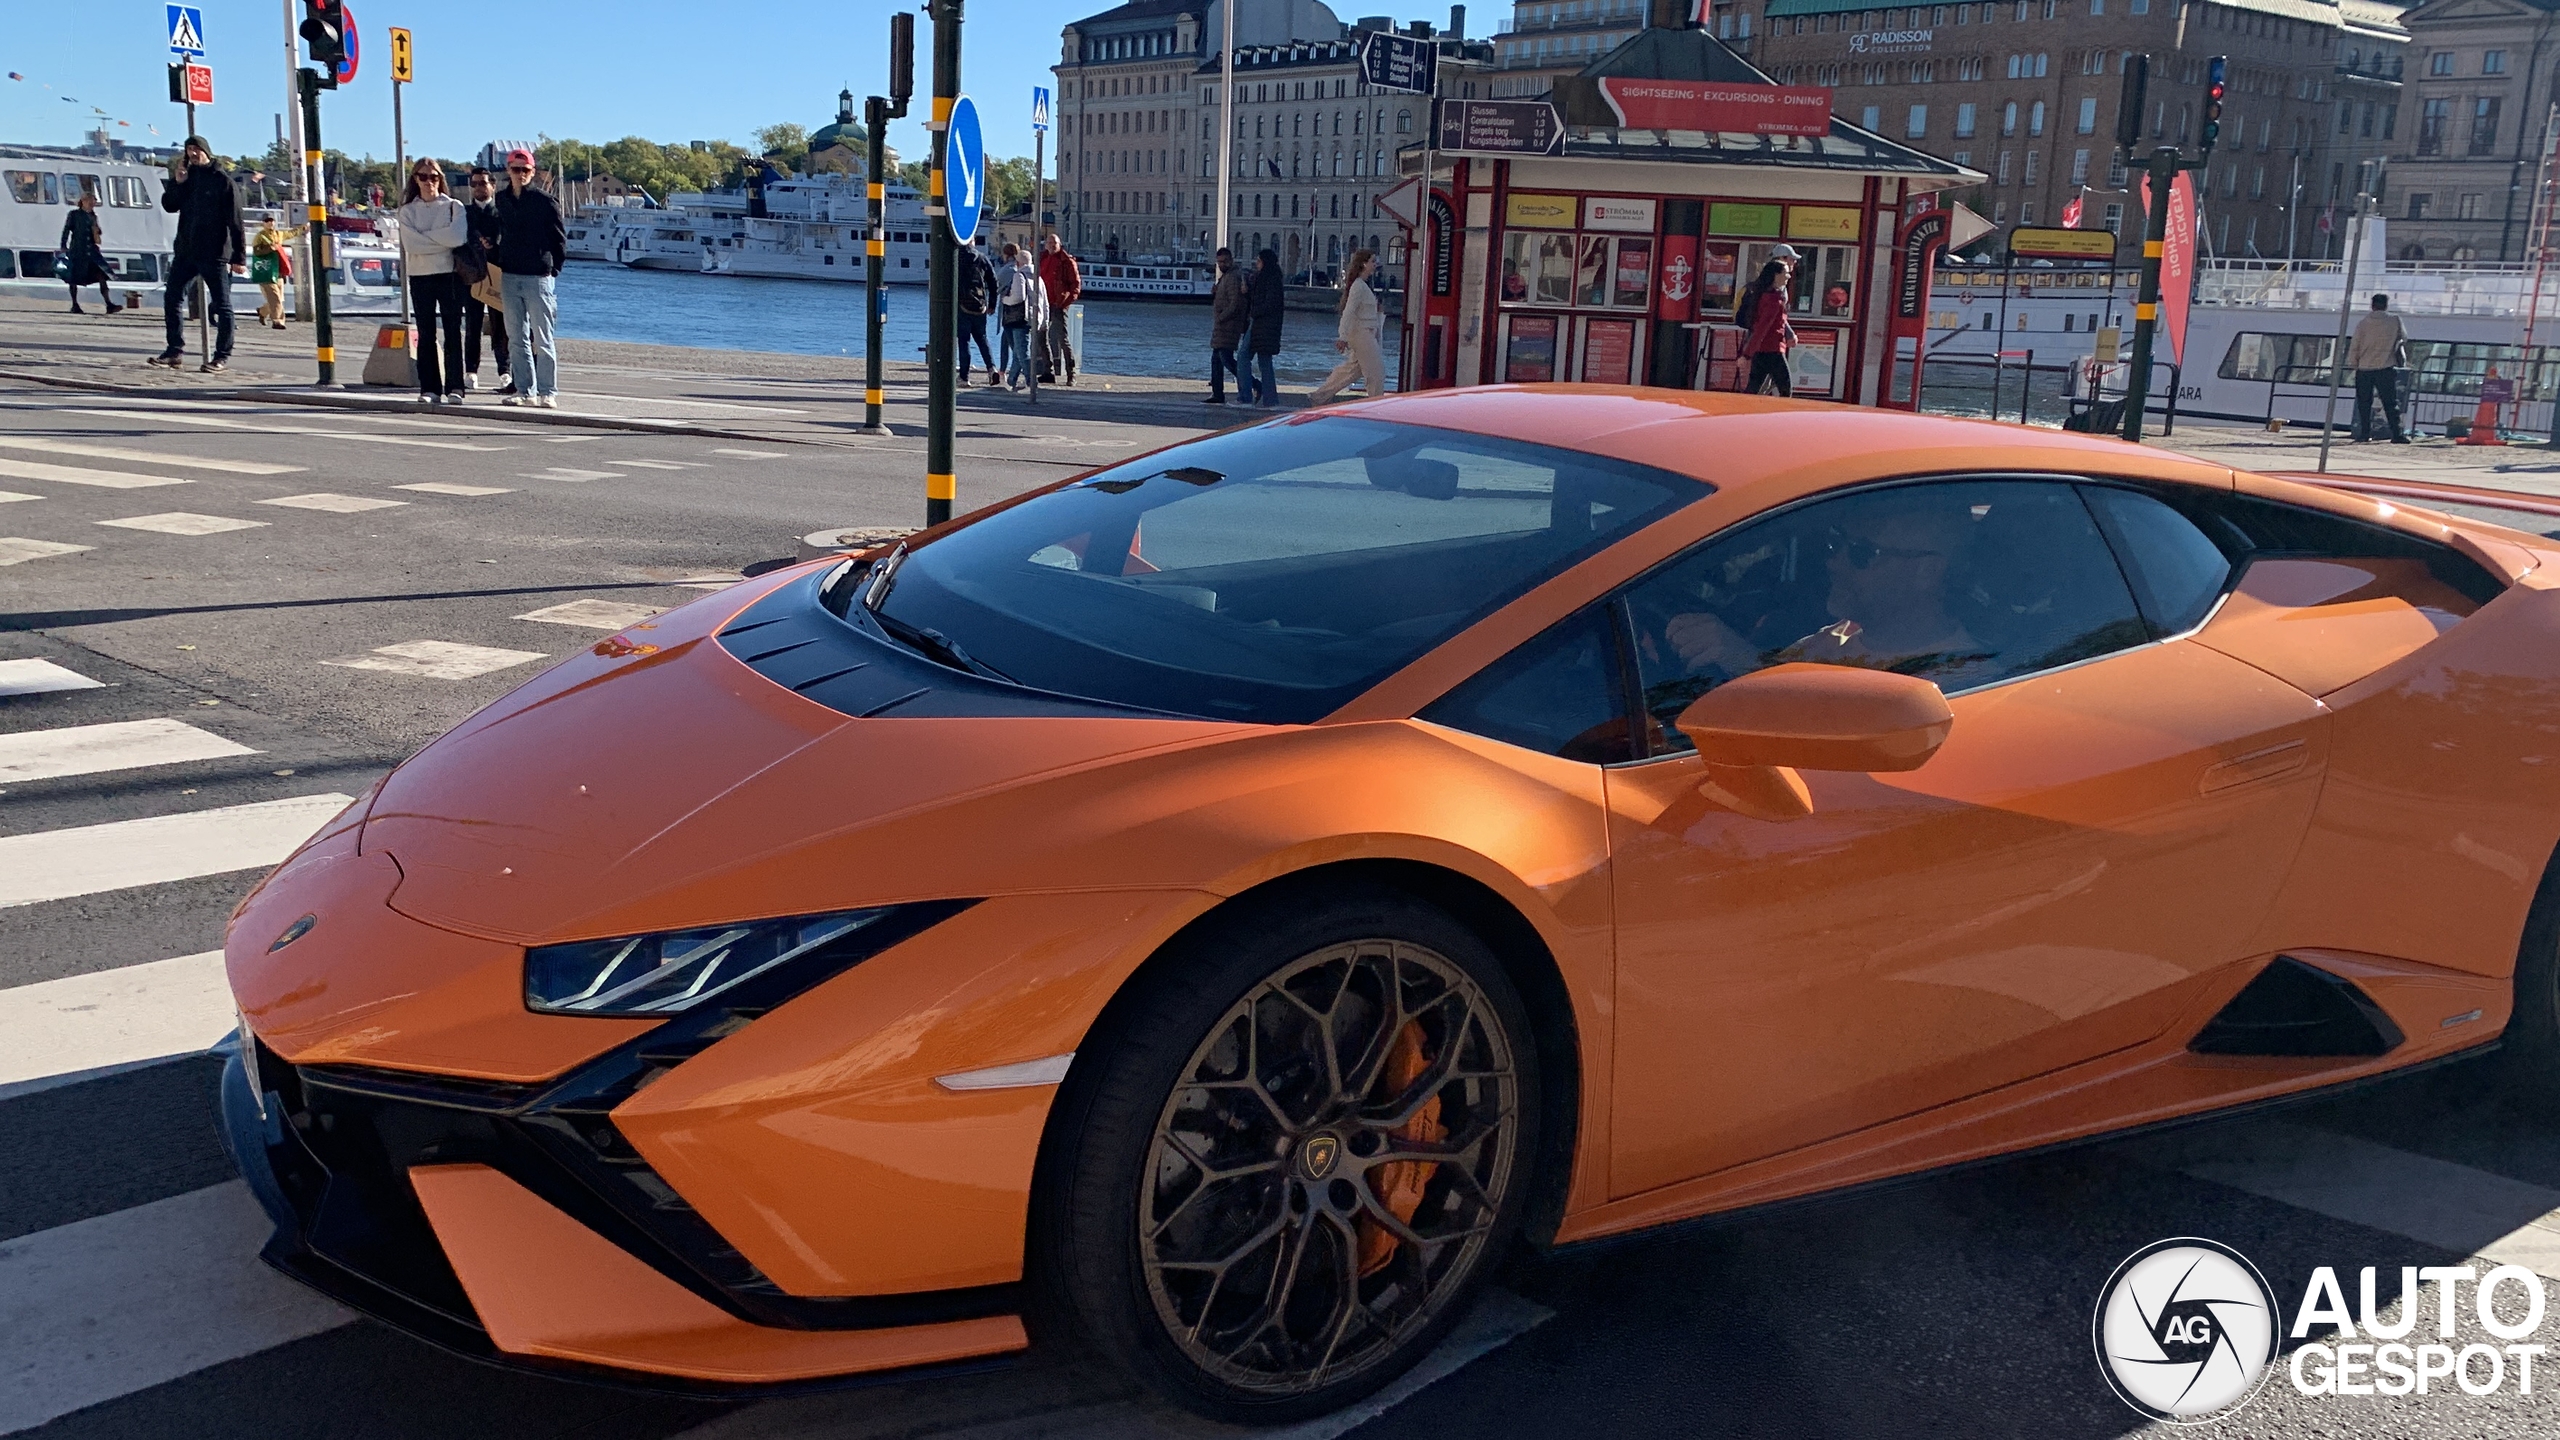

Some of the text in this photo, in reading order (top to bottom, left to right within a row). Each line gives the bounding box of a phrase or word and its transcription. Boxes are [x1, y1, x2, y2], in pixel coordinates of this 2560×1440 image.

[1872, 29, 1933, 44] RADISSON
[1871, 44, 1932, 53] COLLECTION
[1621, 86, 1824, 106] SIGHTSEEING EXCURSIONS DINING
[1471, 106, 1497, 116] Slussen
[1470, 116, 1515, 126] Centralstation
[1470, 126, 1494, 137] Sergels
[1495, 128, 1509, 137] torg
[1081, 280, 1145, 289] TOCKHOLMS
[2165, 385, 2202, 401] CARA
